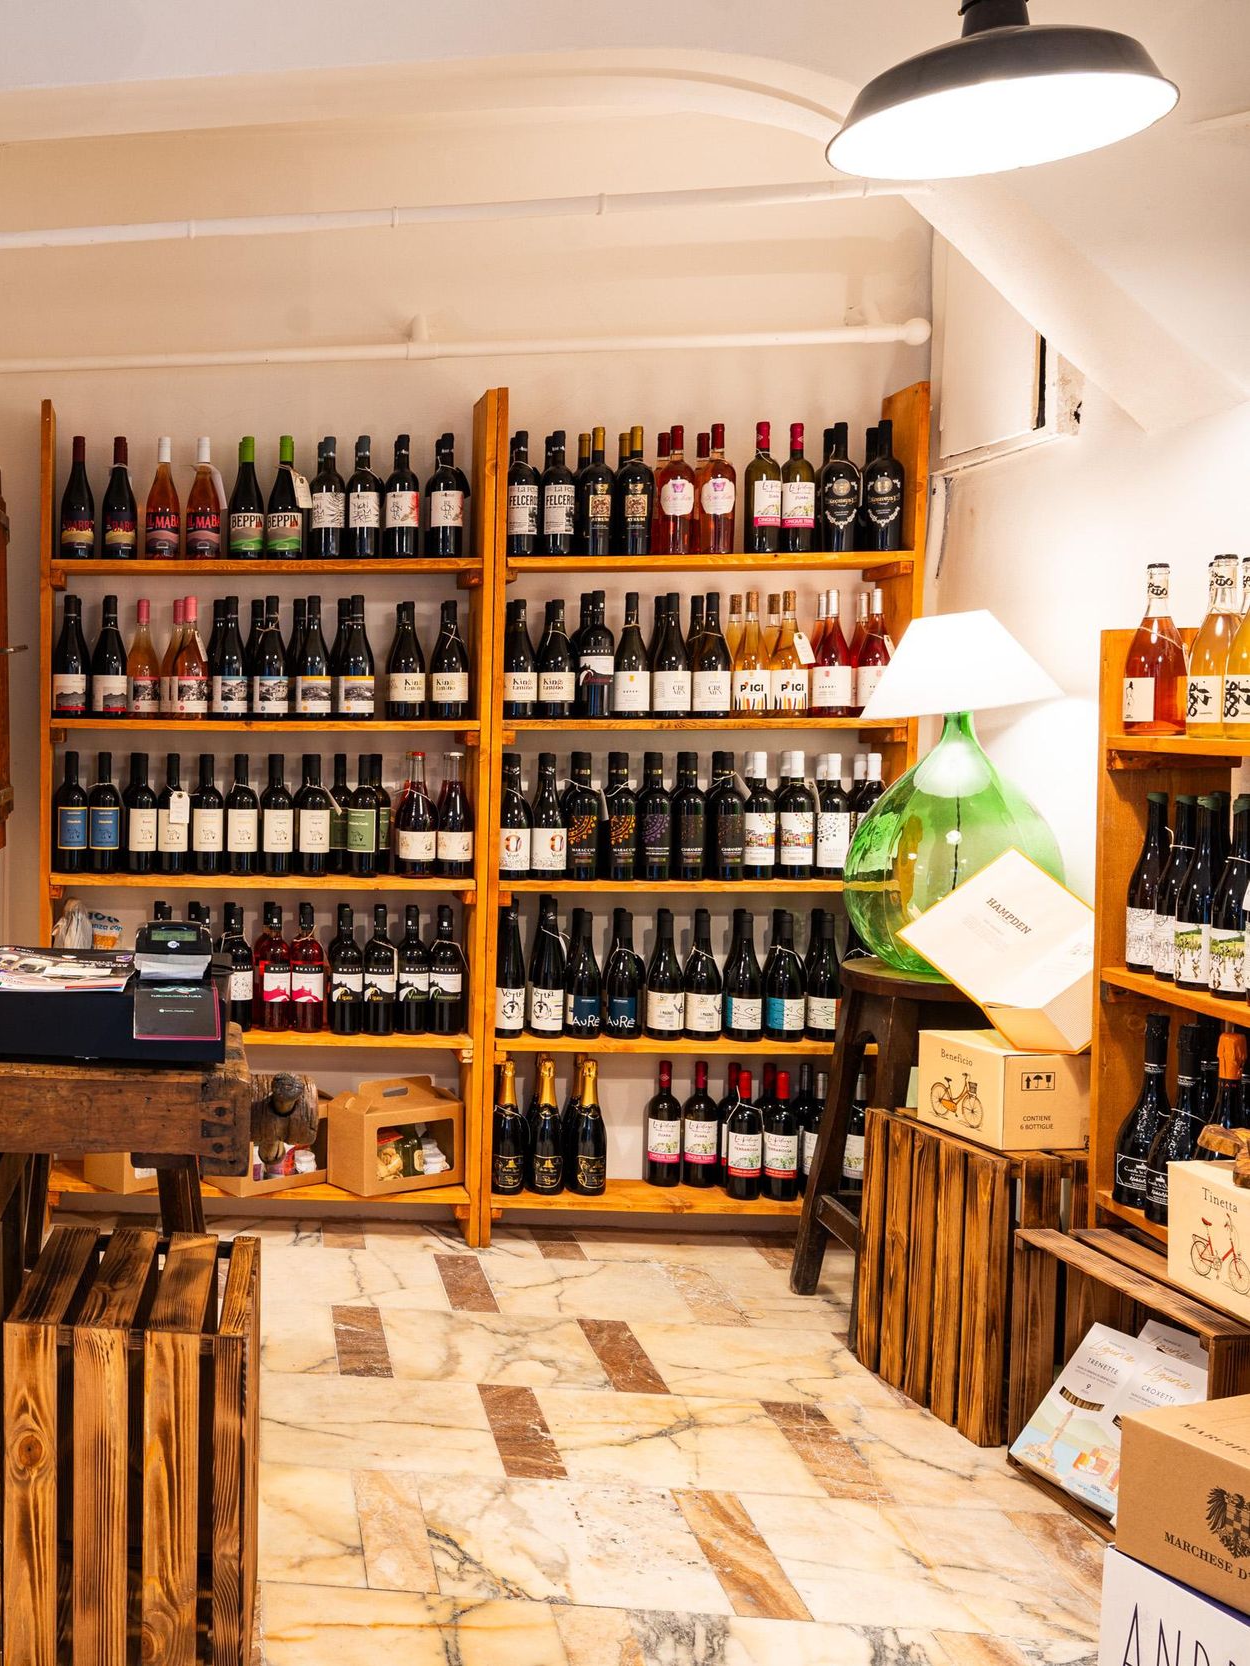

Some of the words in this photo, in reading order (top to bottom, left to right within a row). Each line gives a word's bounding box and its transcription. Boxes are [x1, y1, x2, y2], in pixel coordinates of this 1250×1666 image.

[986, 897, 1032, 934] HAMPDEN
[940, 1048, 973, 1067] Beneficio
[1202, 1187, 1238, 1213] Tinetta
[1087, 1357, 1119, 1376] TRENETTE
[1141, 1384, 1176, 1403] CROXETTI
[1163, 1530, 1234, 1575] MARCHESE
